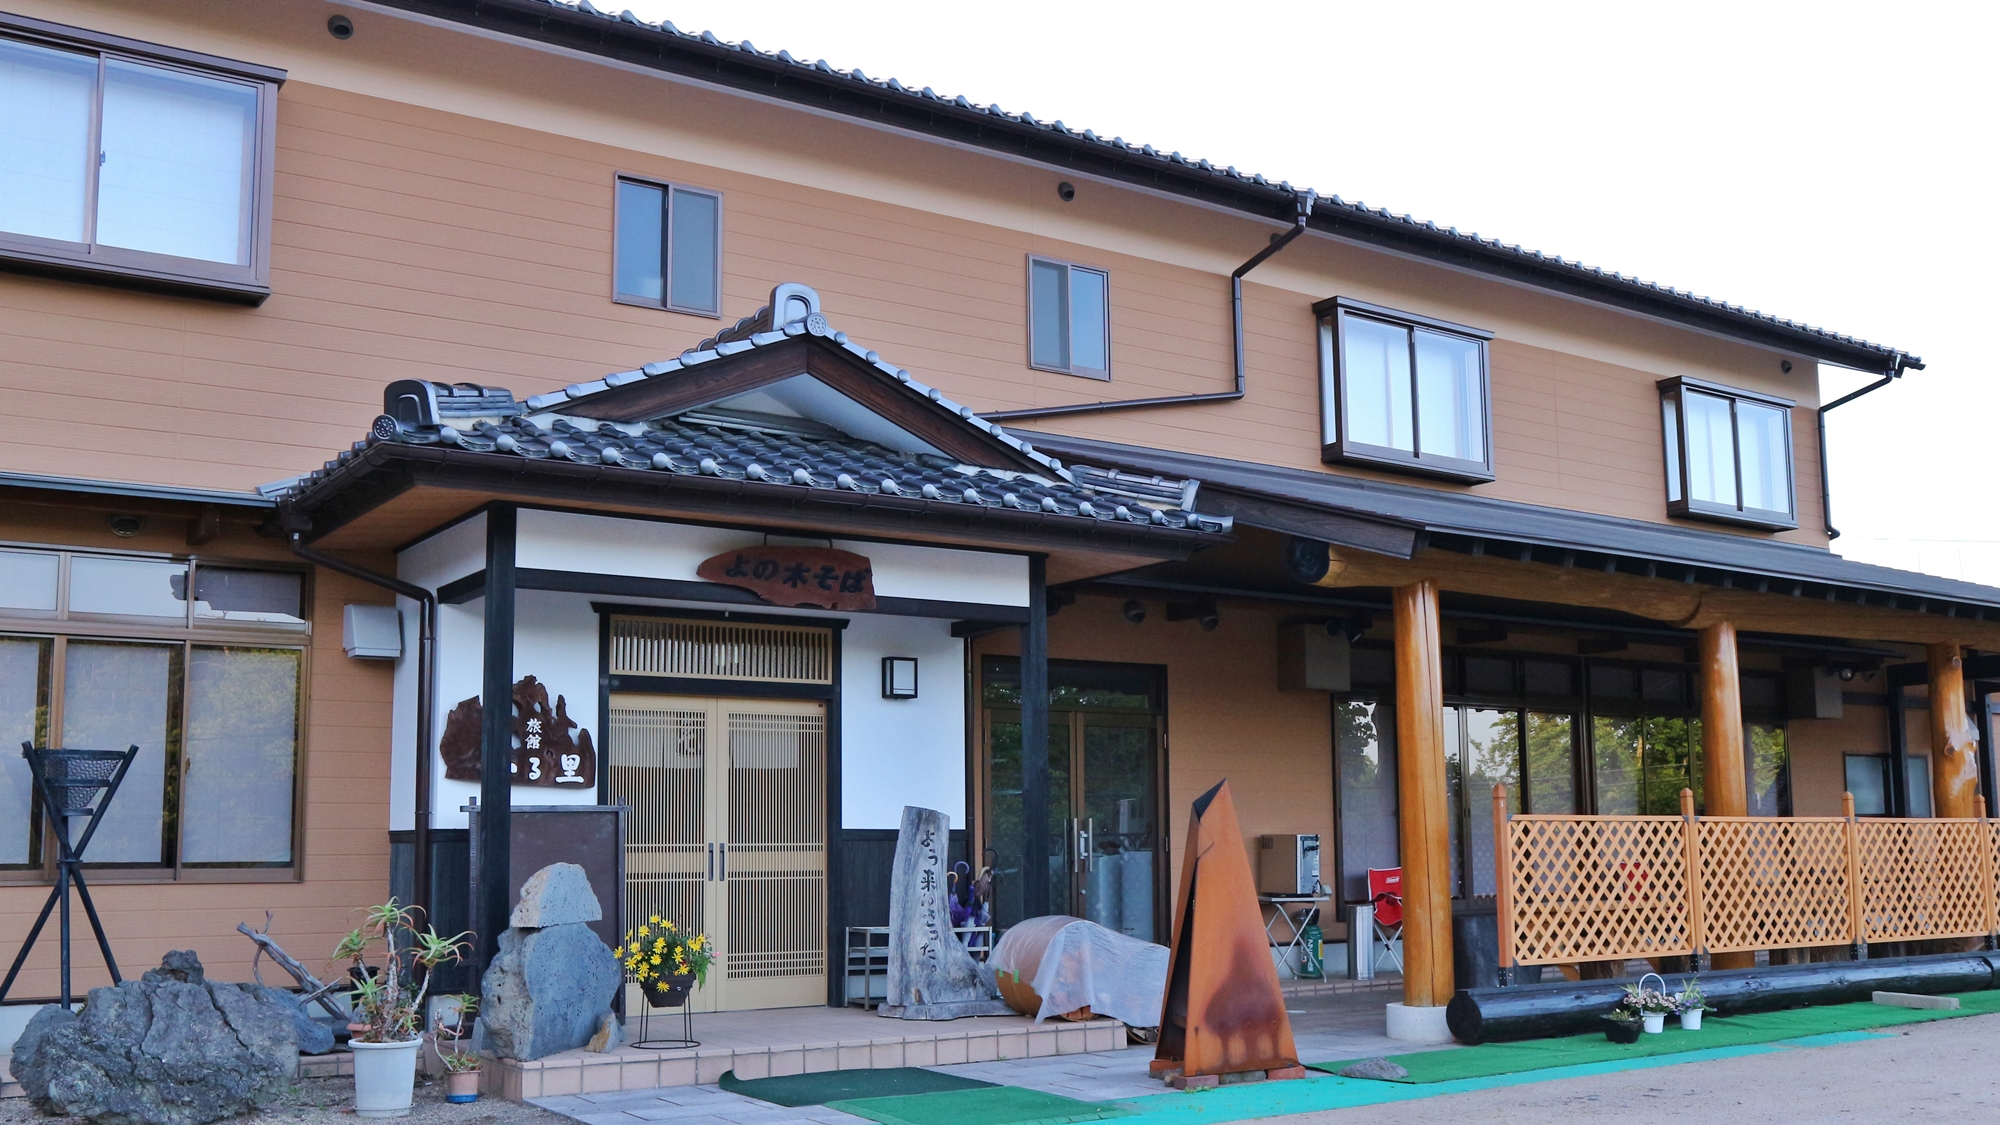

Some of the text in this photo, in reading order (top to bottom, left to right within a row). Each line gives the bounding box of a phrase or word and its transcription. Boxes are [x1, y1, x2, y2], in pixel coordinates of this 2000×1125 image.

[725, 554, 872, 594] よの木そば
[524, 717, 543, 750] 旅館
[510, 753, 585, 785] る里
